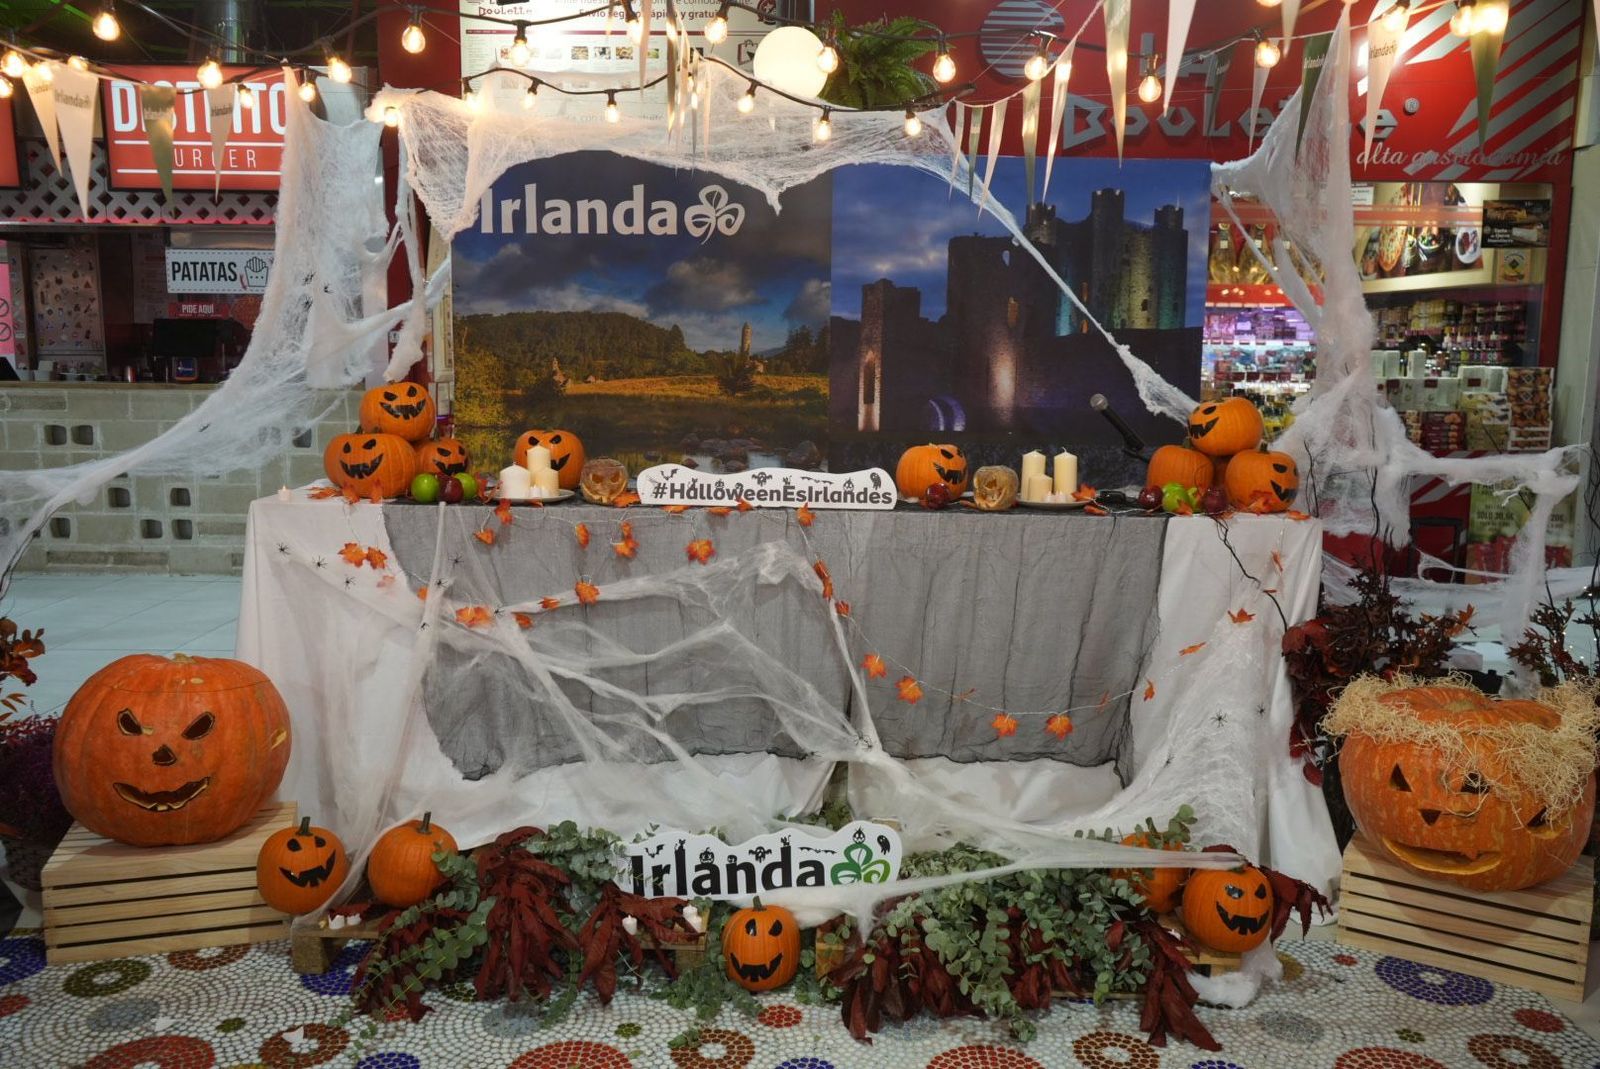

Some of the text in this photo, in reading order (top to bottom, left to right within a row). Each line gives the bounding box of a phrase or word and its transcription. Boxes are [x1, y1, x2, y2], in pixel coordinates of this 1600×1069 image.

[1356, 141, 1407, 165] alta
[480, 183, 678, 235] Irlanda
[171, 261, 238, 282] PATATAS
[182, 303, 214, 314] PIDE AQUÍ
[652, 481, 893, 505] #HalloweenEsIrlandes
[631, 845, 826, 897] Irlanda
